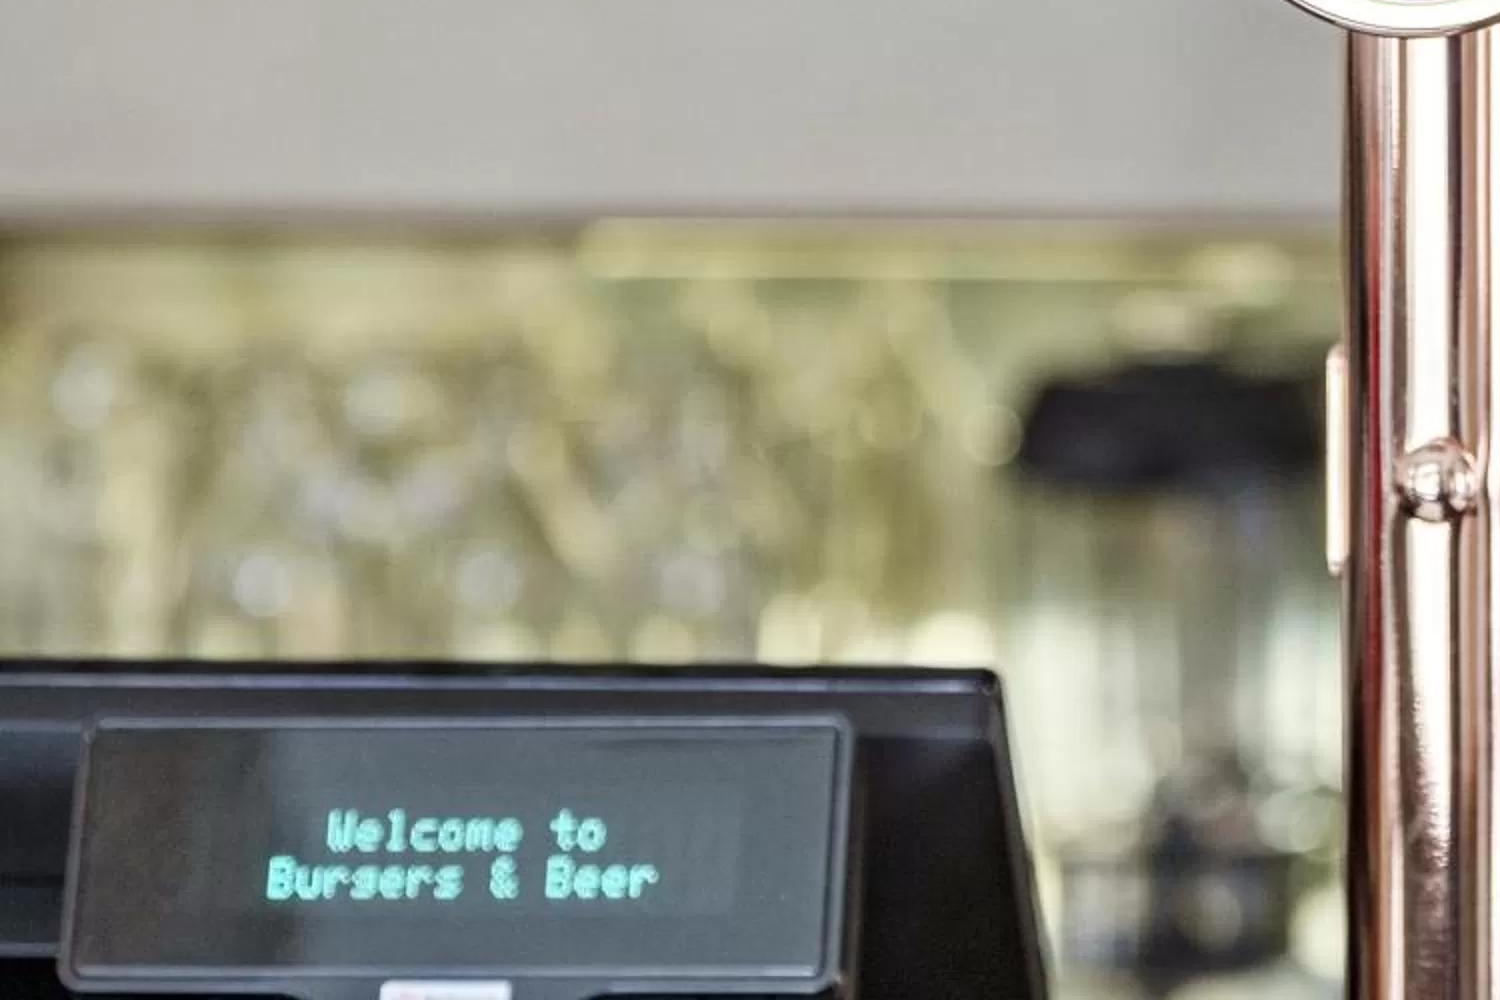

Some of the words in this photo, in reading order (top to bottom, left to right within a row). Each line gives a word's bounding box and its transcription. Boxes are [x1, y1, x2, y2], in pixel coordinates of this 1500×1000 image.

[325, 807, 525, 854] Welcome
[549, 807, 608, 853] to
[266, 854, 465, 901] Burgers
[489, 853, 520, 901] &
[545, 853, 661, 901] Beer
